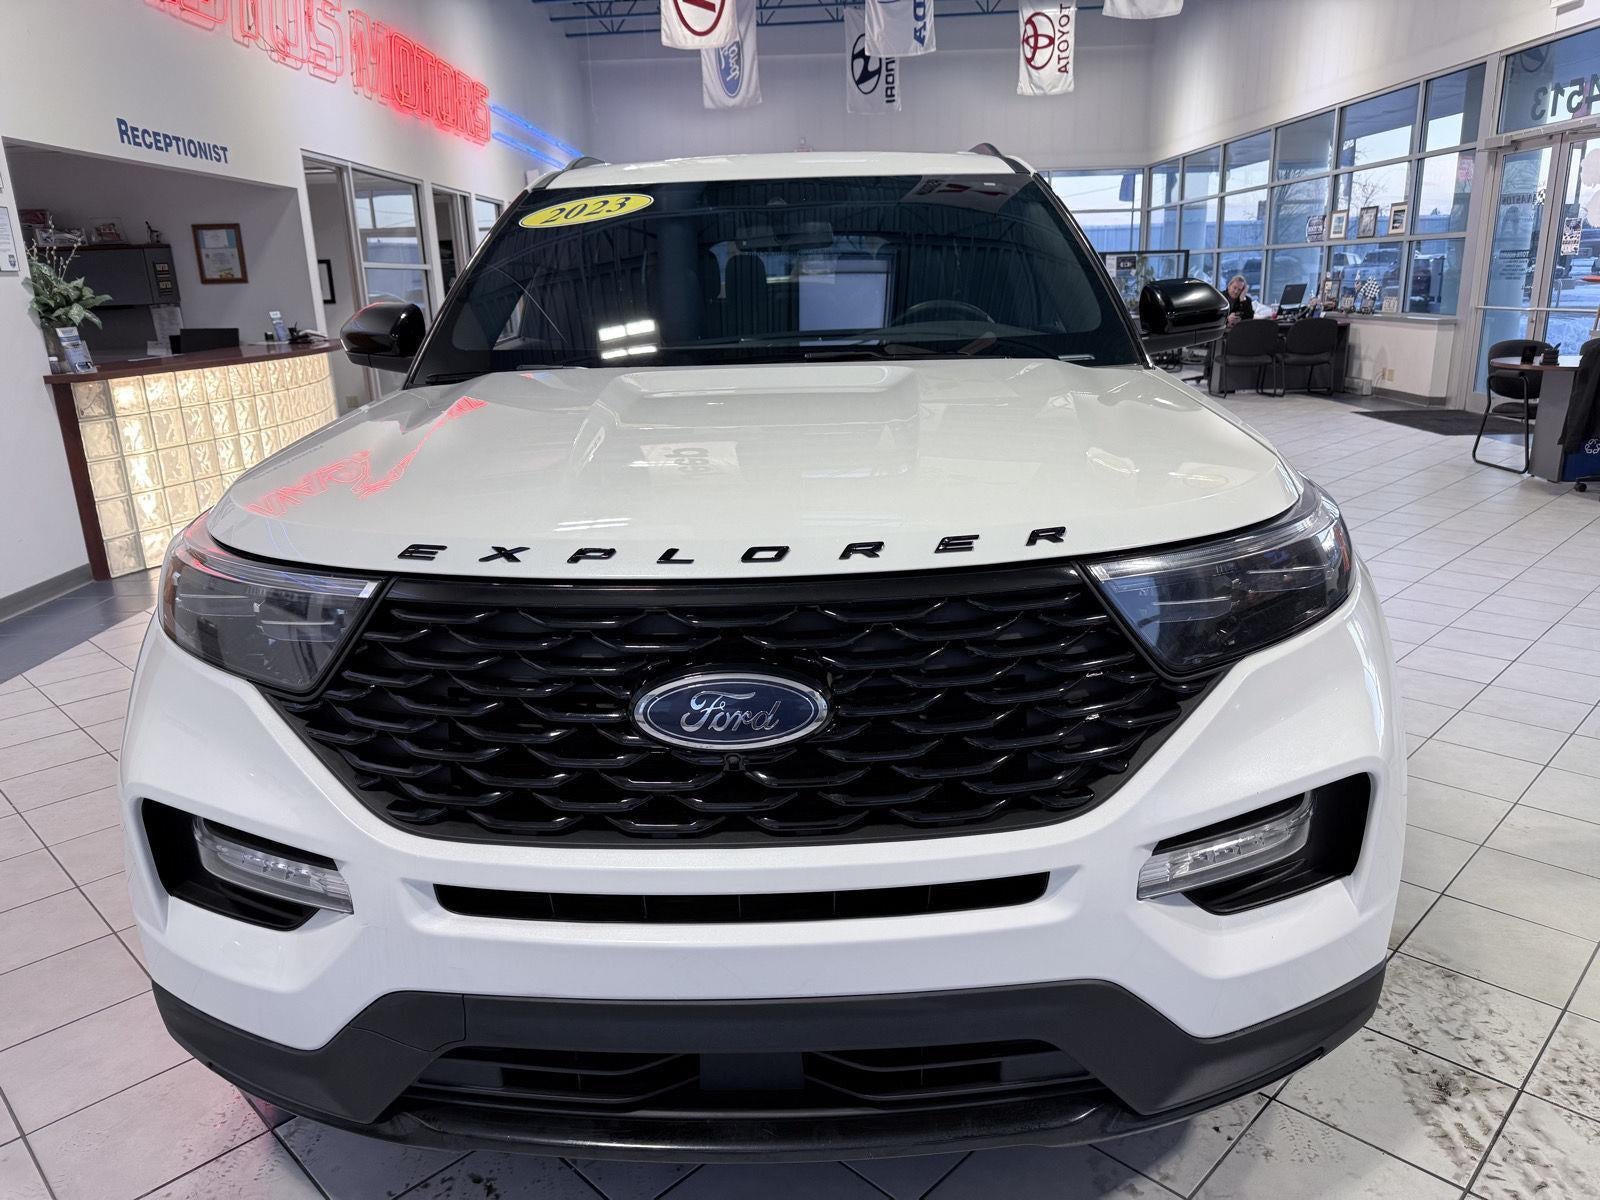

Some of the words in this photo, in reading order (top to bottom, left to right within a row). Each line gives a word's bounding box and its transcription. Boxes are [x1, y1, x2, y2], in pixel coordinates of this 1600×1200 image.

[348, 8, 491, 144] MOTORS
[116, 117, 228, 164] RECEPTIONIST
[540, 196, 631, 224] 2023
[397, 526, 1067, 564] EXPLORER
[680, 690, 782, 732] Ford
